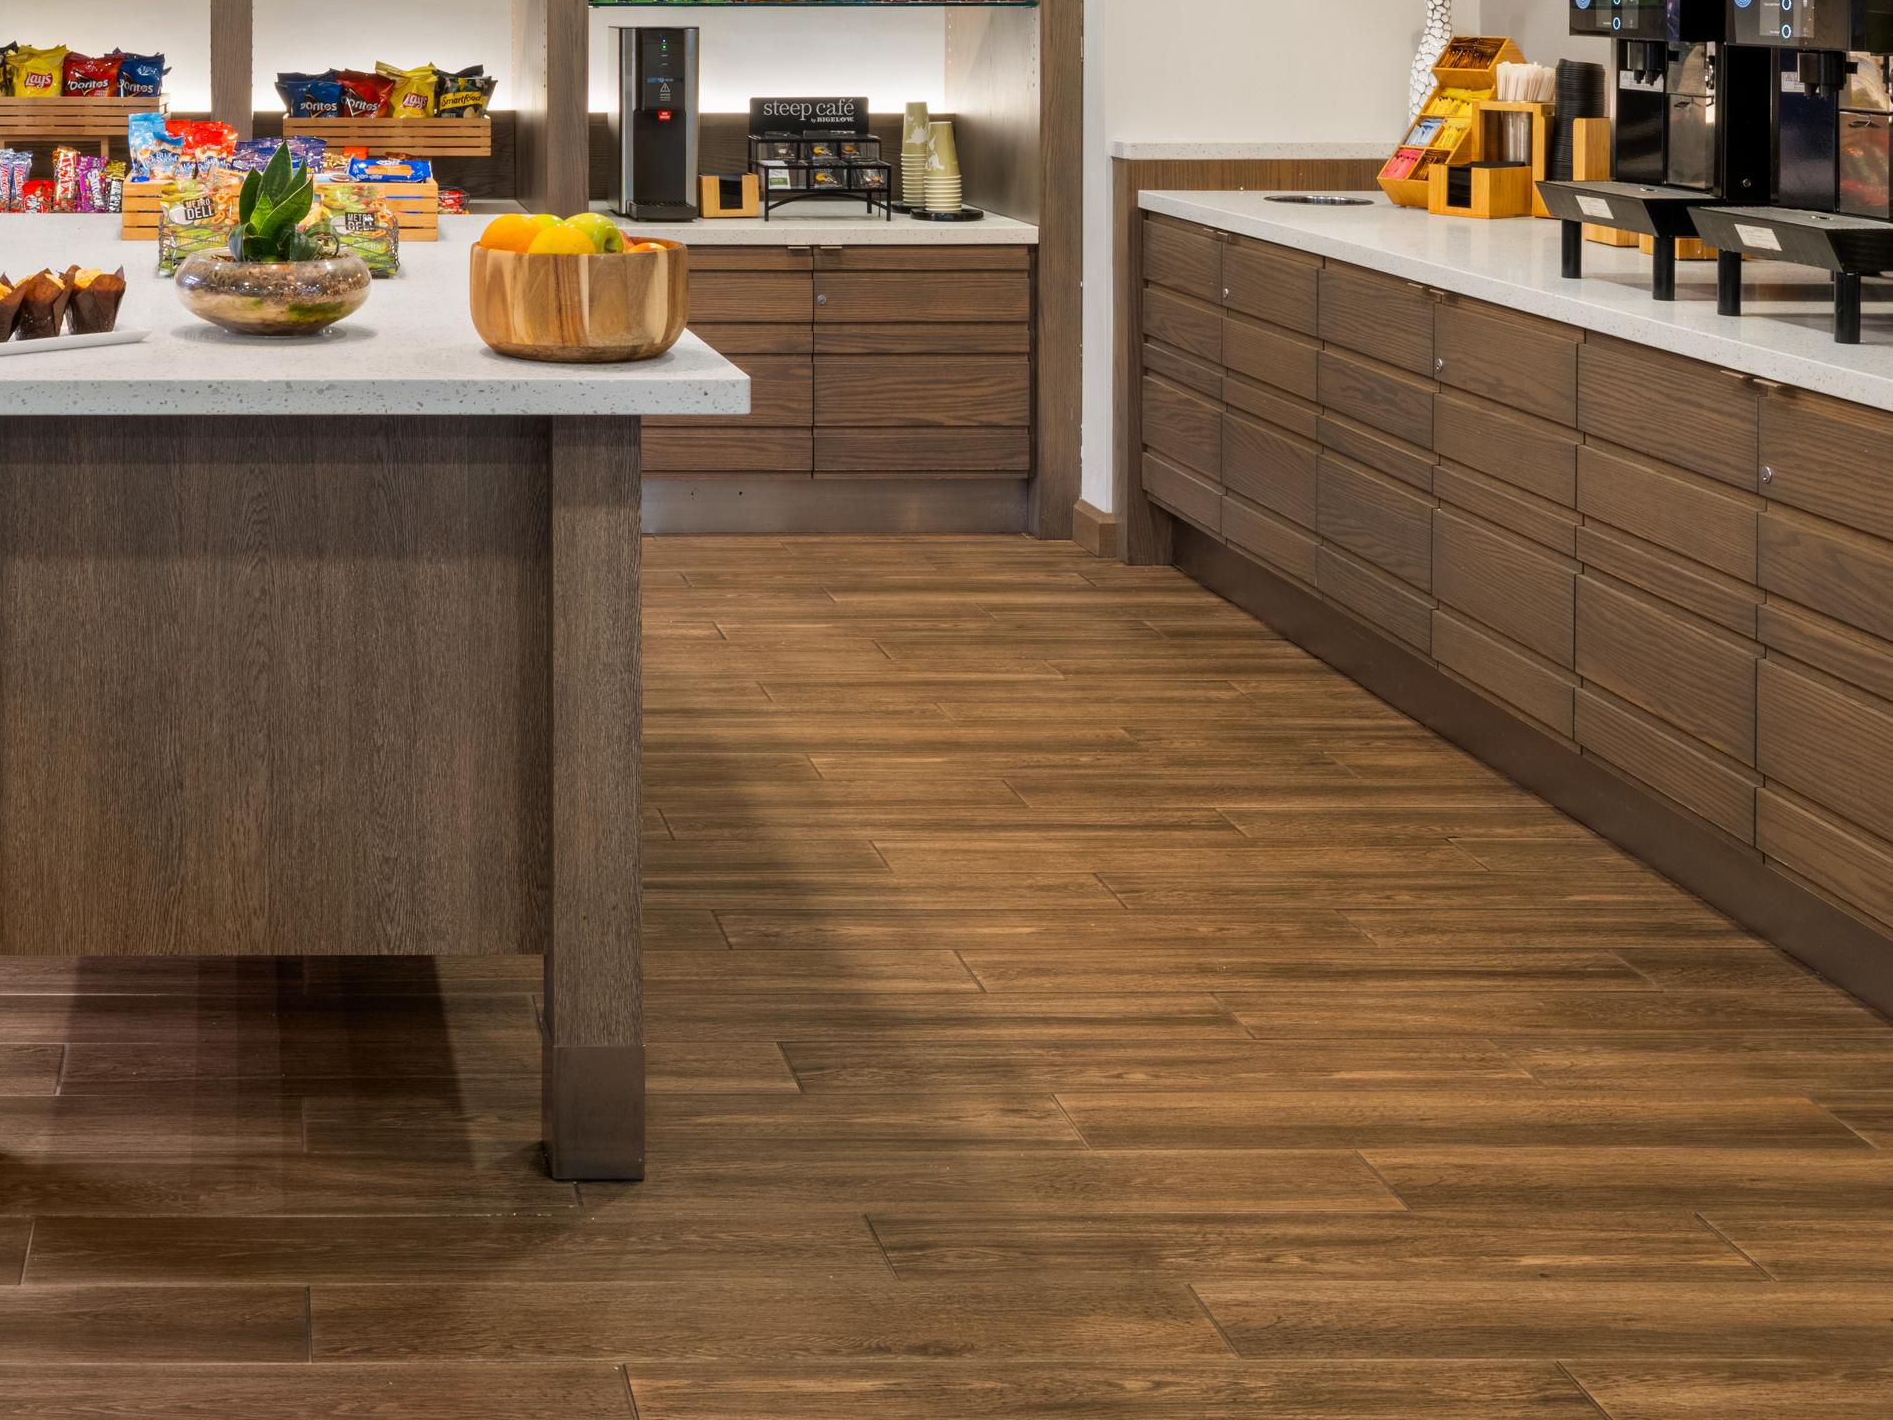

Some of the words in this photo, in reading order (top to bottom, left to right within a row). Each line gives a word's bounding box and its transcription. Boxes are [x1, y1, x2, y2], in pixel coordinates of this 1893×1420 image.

[69, 78, 109, 90] Doritos
[441, 93, 481, 107] Smartfood
[763, 100, 812, 120] steep
[816, 99, 854, 116] café
[186, 205, 214, 220] DELI
